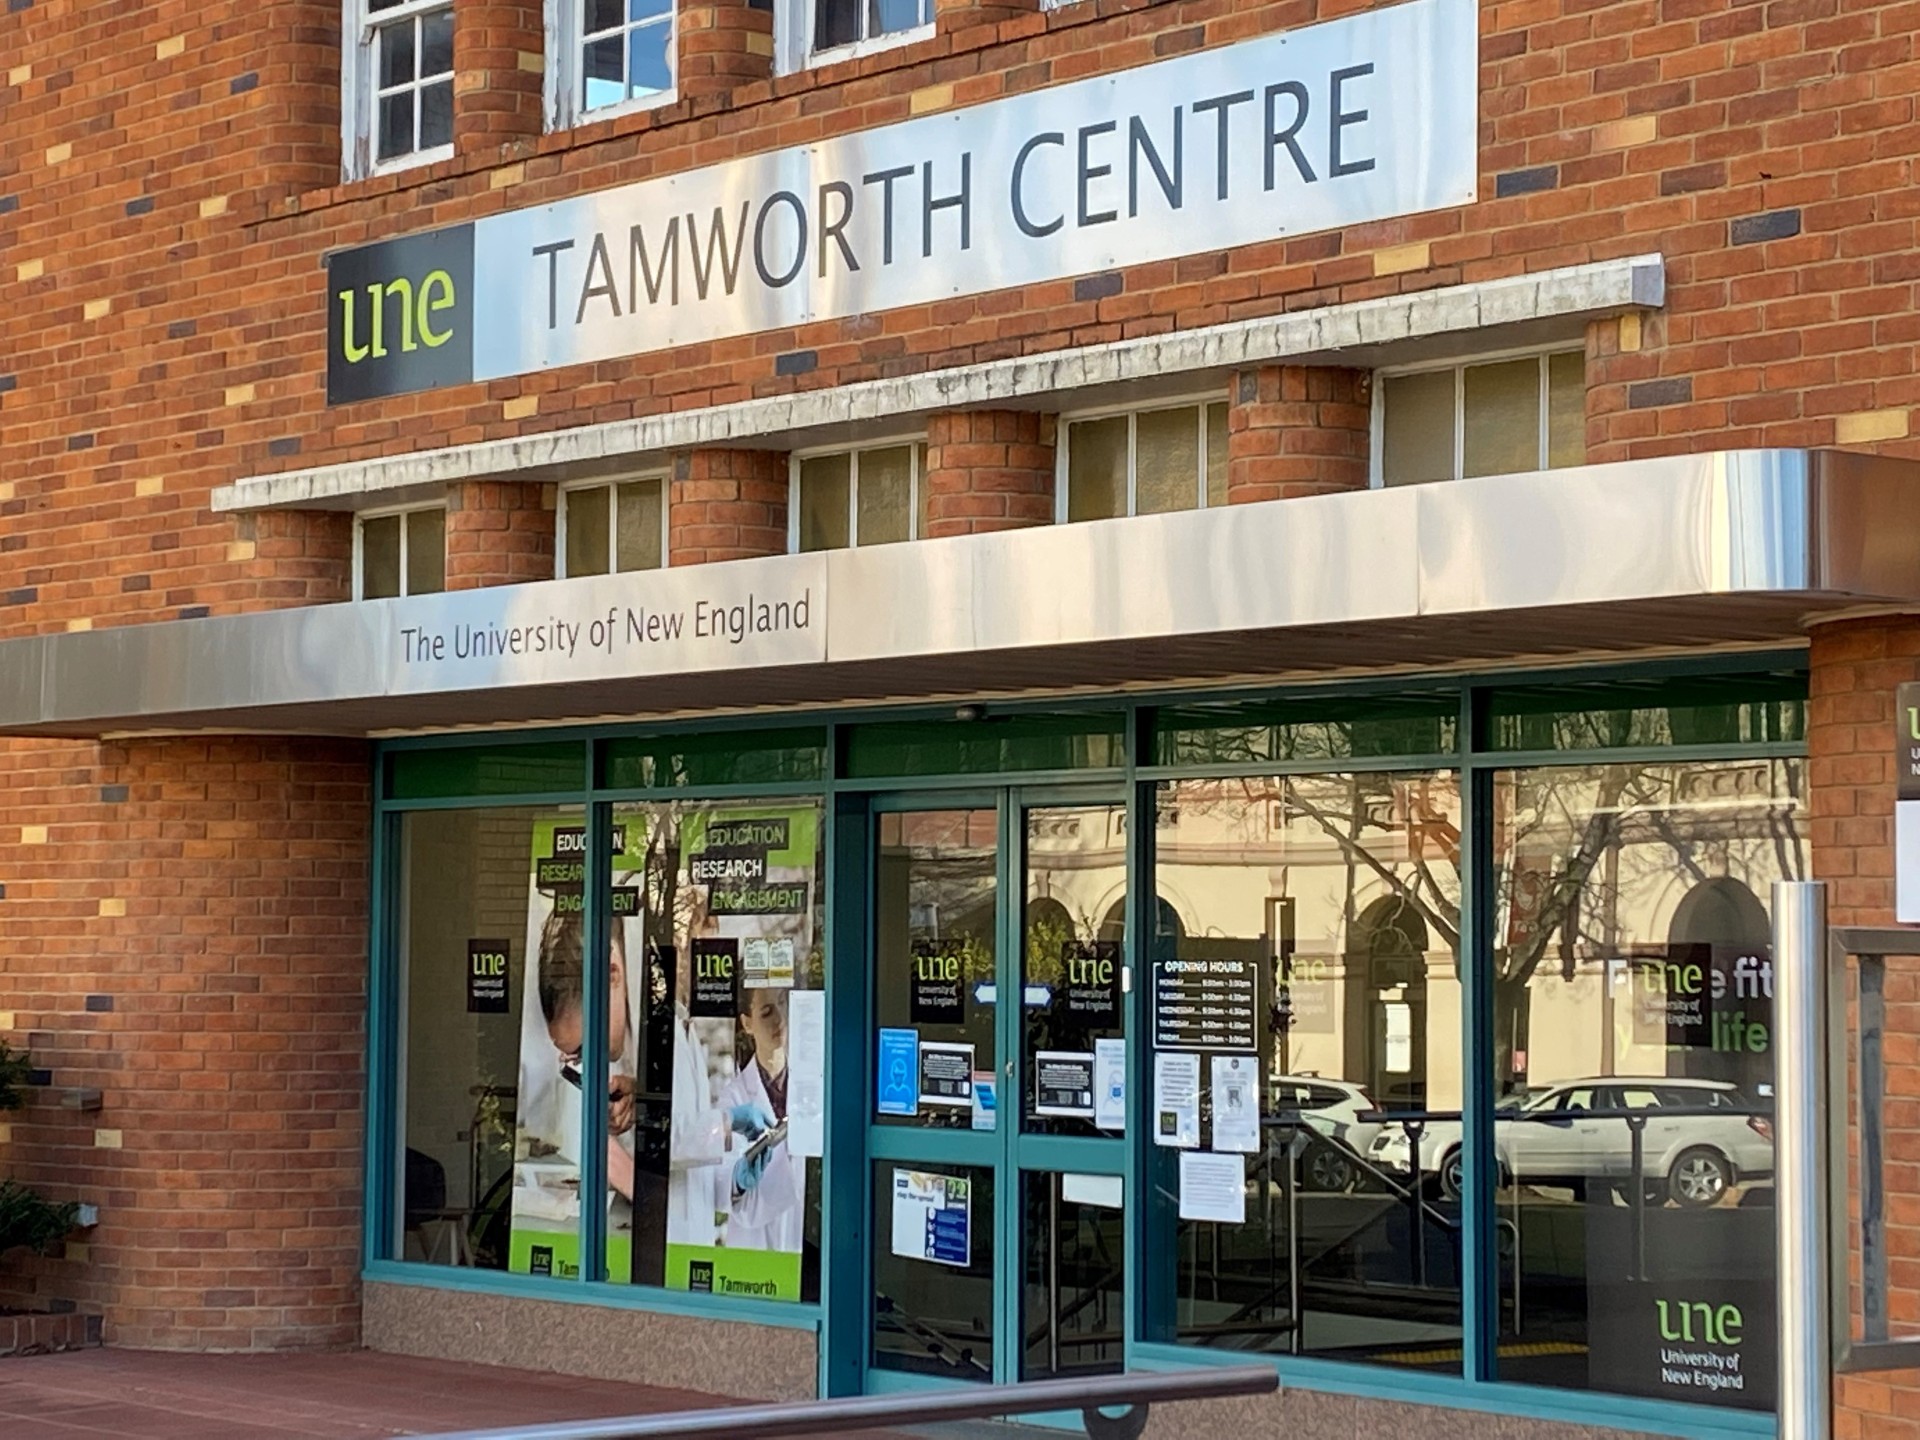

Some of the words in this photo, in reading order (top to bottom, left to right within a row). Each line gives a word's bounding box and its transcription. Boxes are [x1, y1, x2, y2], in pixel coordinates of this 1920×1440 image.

[533, 152, 971, 330] TAMWORTH
[1010, 63, 1376, 237] CENTRE
[339, 269, 455, 363] une
[401, 626, 445, 662] The
[454, 616, 580, 658] University
[589, 607, 618, 654] of
[626, 607, 684, 643] New
[695, 588, 810, 643] England
[709, 825, 785, 847] EDUCATION
[540, 864, 584, 881] RESEAR
[692, 858, 763, 880] RESEARCH
[711, 889, 804, 909] ENGAGEMENT
[472, 953, 505, 975] une
[696, 954, 733, 977] une
[917, 956, 958, 980] une
[1068, 959, 1113, 984] une
[1164, 961, 1208, 973] OPENING
[1209, 961, 1244, 973] HOURS
[1641, 963, 1702, 993] une
[1733, 956, 1773, 999] fit
[1711, 1011, 1768, 1052] life
[719, 1275, 776, 1296] Tamworth
[1655, 1300, 1742, 1345] une
[1661, 1349, 1724, 1370] University
[1725, 1353, 1740, 1371] of
[1662, 1368, 1691, 1384] New
[1694, 1371, 1743, 1390] England
